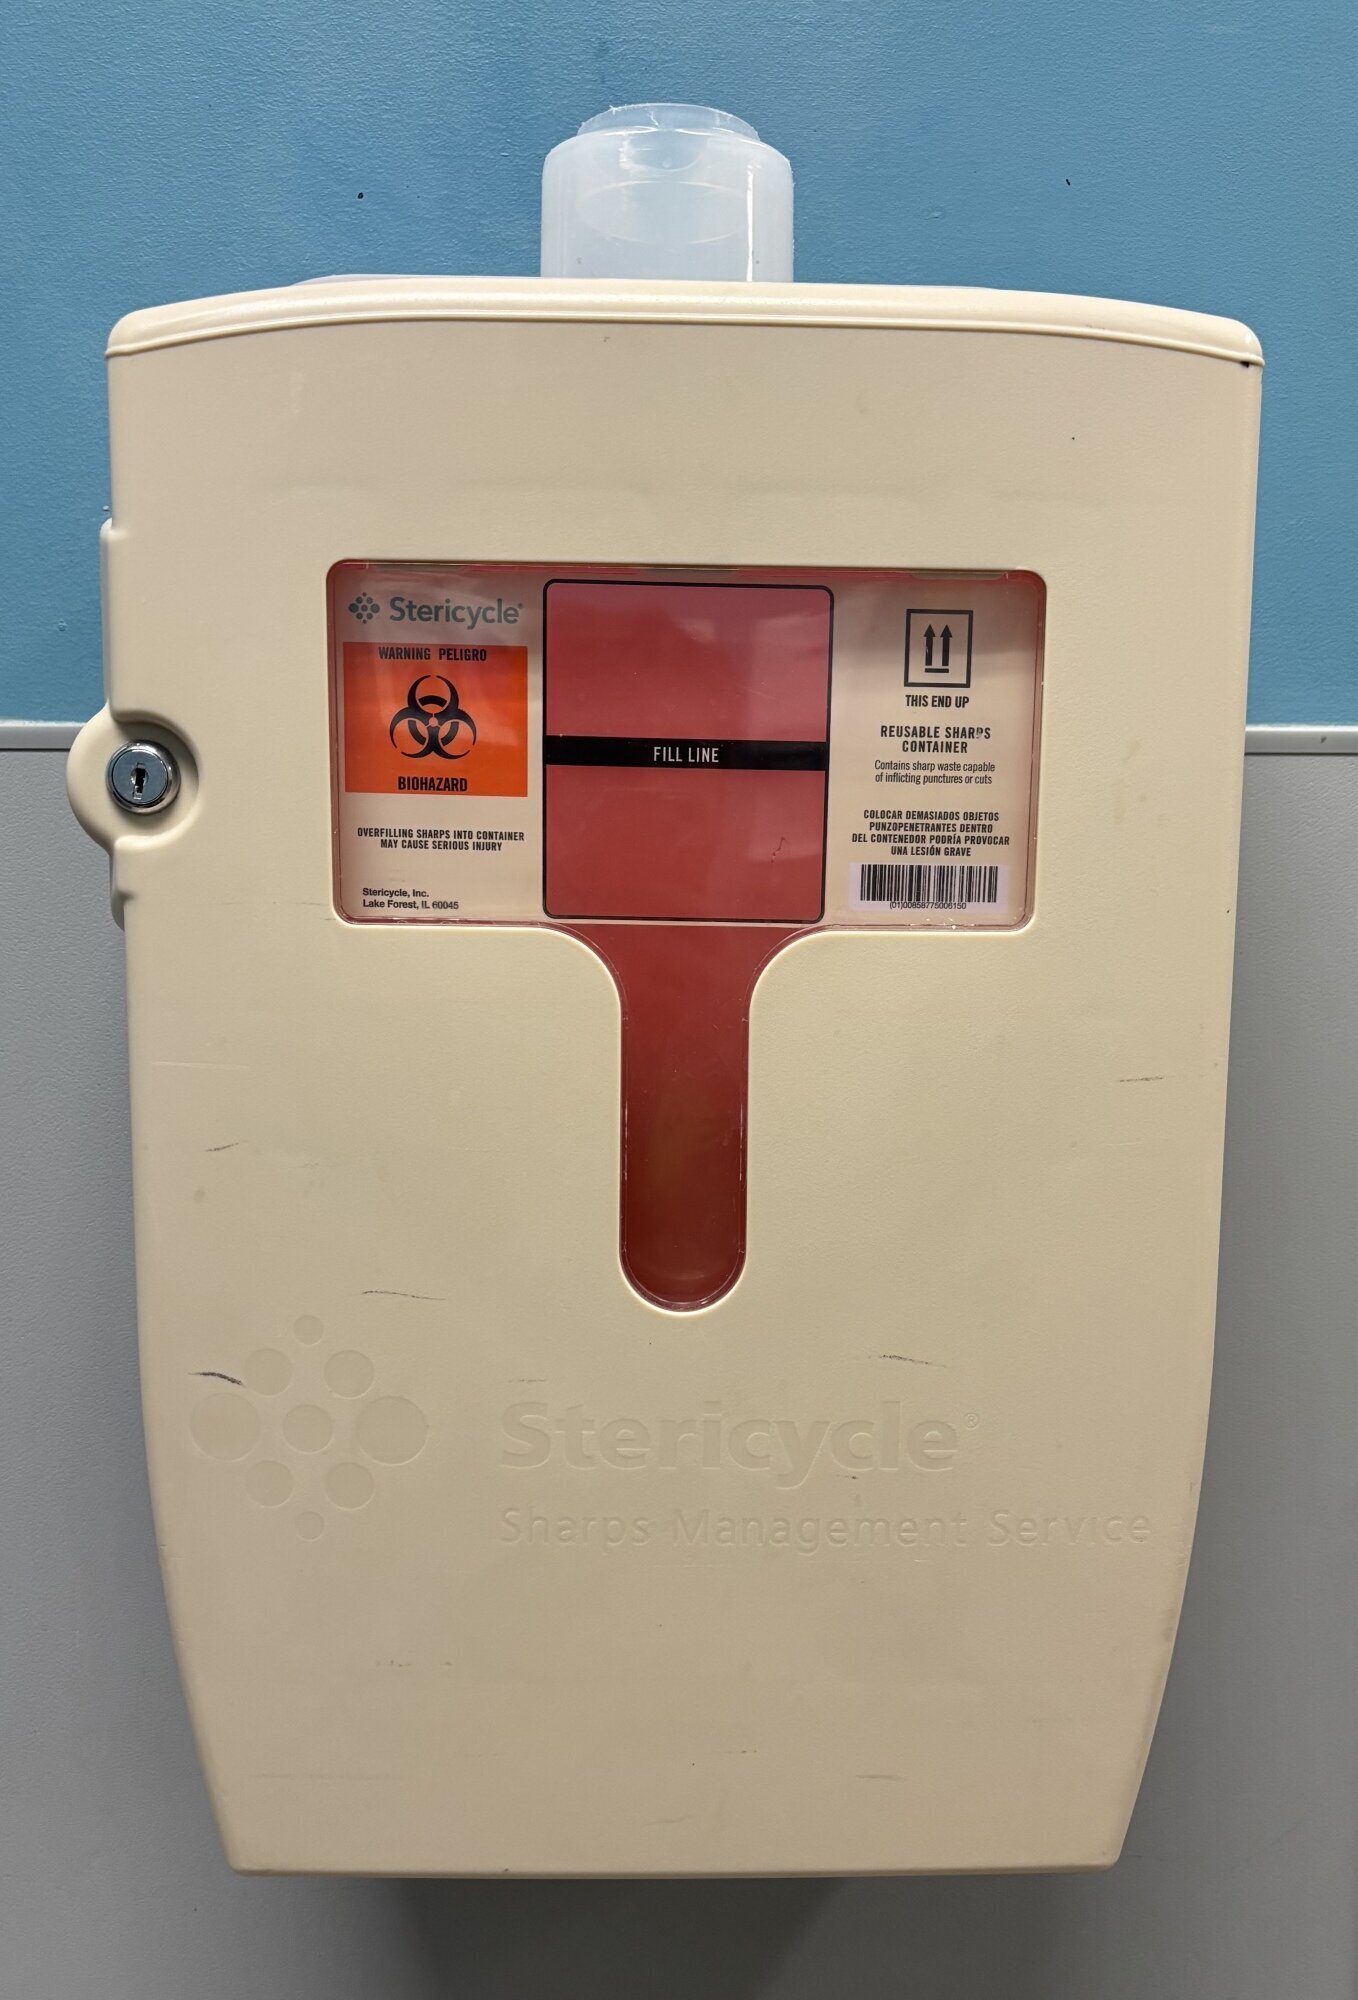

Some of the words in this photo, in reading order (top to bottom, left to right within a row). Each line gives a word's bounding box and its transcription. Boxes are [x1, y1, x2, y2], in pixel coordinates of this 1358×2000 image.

[378, 646, 431, 660] WARNING
[438, 647, 487, 662] PELIGRO
[905, 694, 929, 707] THIS
[931, 695, 952, 708] END
[955, 696, 970, 708] UP
[880, 725, 940, 738] REUSABLE
[944, 726, 991, 740] SHARPS
[902, 740, 968, 753] CONTAINER
[653, 746, 683, 762] FILL
[688, 747, 720, 763] LINE
[874, 760, 910, 771] Contains
[912, 760, 935, 773] sharp
[937, 762, 961, 772] waste
[963, 761, 996, 774] capable
[397, 776, 468, 792] BIOHAZARD
[875, 772, 883, 783] of
[885, 772, 921, 785] inflicting
[922, 773, 963, 785] punctures
[965, 775, 973, 784] or
[974, 774, 993, 784] cuts
[863, 809, 903, 819] COLOCAR
[905, 810, 960, 821] DEMASIADOS
[963, 811, 1000, 821] OBJETOS
[869, 821, 957, 833] PUNZOPENETRANTES
[959, 823, 993, 833] DENTRO
[357, 827, 414, 839] OVERFILLING
[416, 829, 451, 839] SHARPS
[453, 830, 474, 840] INTO
[476, 831, 525, 841] CONTAINER
[852, 833, 868, 843] DEL
[870, 834, 926, 844] CONTENEDOR
[929, 834, 962, 845] PODRÍA
[964, 835, 1010, 845] PROVOCAR
[380, 839, 398, 849] MAY
[401, 839, 429, 849] CAUSE
[432, 840, 470, 850] SERIOUS
[472, 841, 503, 851] INJURY
[890, 846, 908, 856] UNA
[910, 845, 941, 856] LESIÓN
[943, 847, 971, 857] GRAVE
[362, 887, 410, 898] Stericycle,
[412, 889, 430, 898] Inc.
[362, 899, 385, 908] Lake
[387, 899, 419, 910] Forest,
[421, 900, 430, 909] IL
[432, 901, 459, 910] 60045
[500, 1506, 652, 1556] Sharps
[670, 1507, 969, 1557] Management
[986, 1508, 1152, 1547] Service
